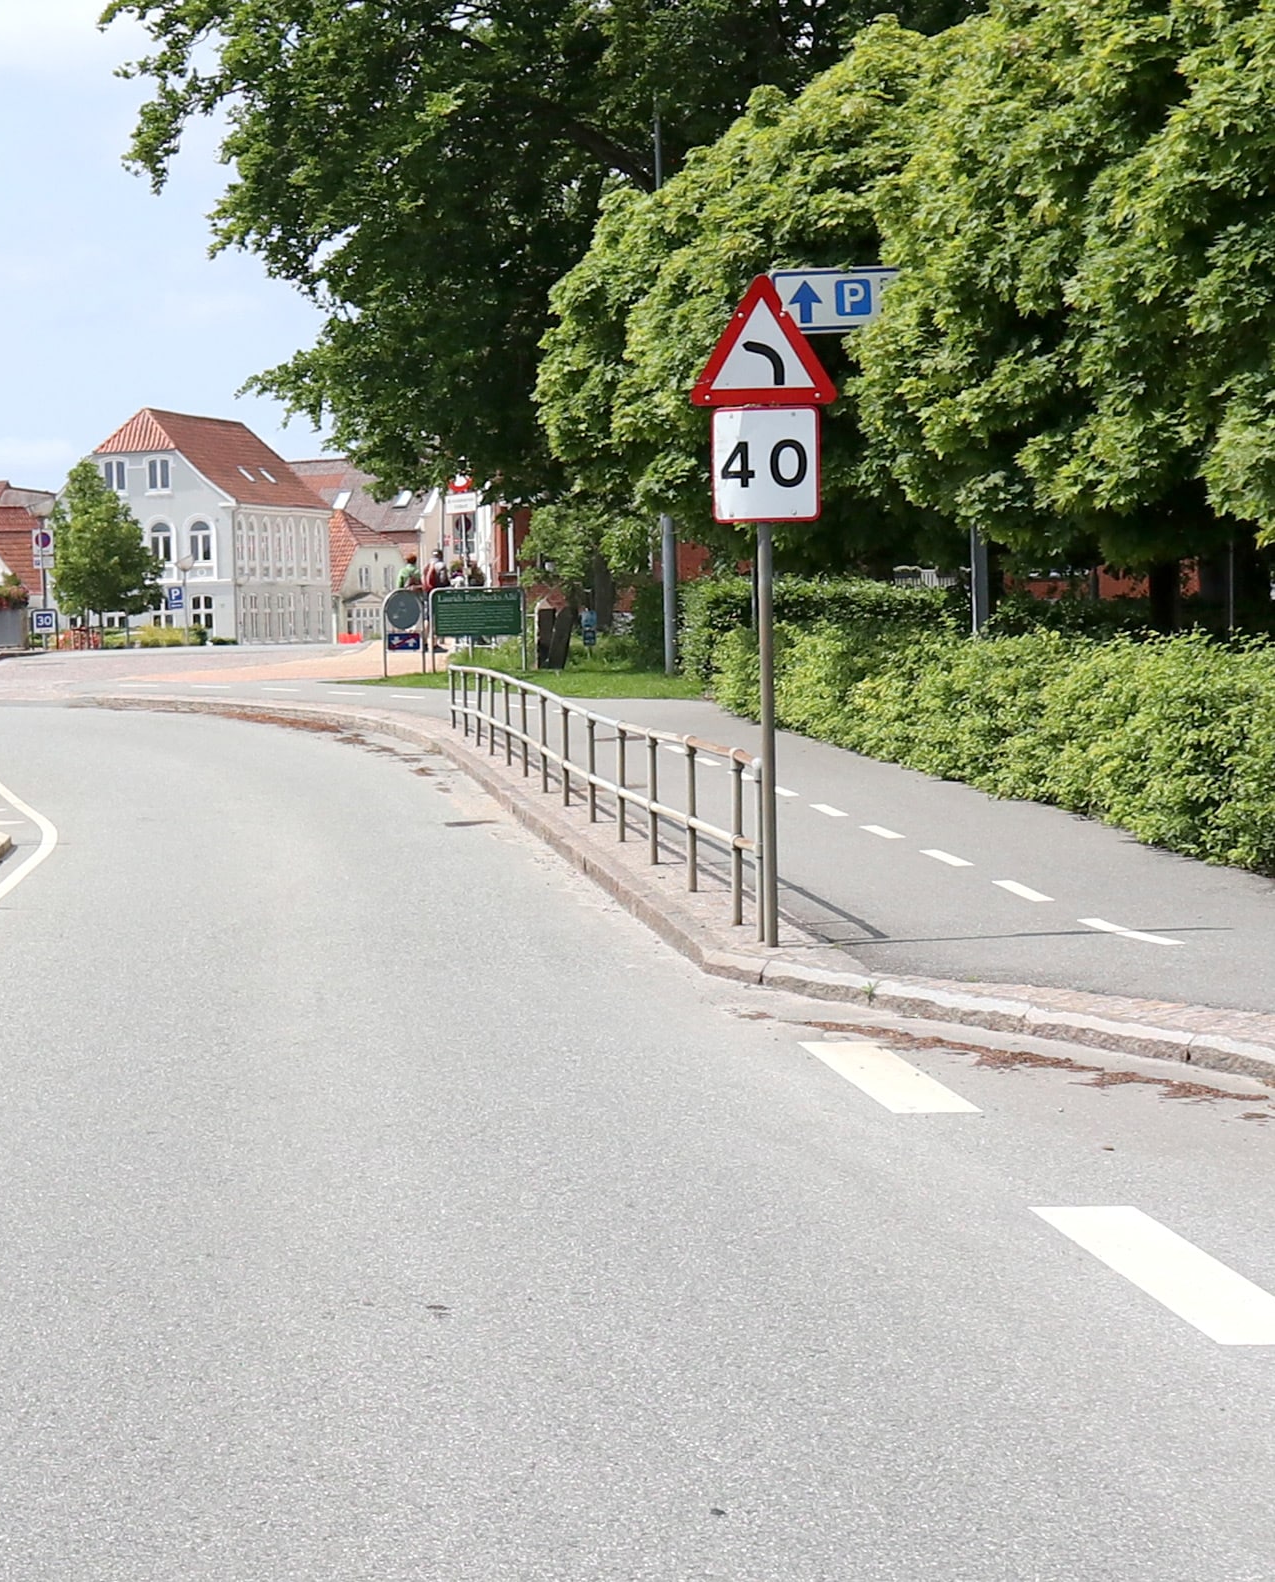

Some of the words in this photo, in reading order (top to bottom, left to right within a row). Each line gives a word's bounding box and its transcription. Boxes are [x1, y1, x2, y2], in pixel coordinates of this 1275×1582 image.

[843, 282, 865, 313] P
[721, 439, 807, 488] 40
[171, 588, 181, 600] P
[37, 615, 52, 626] 30
